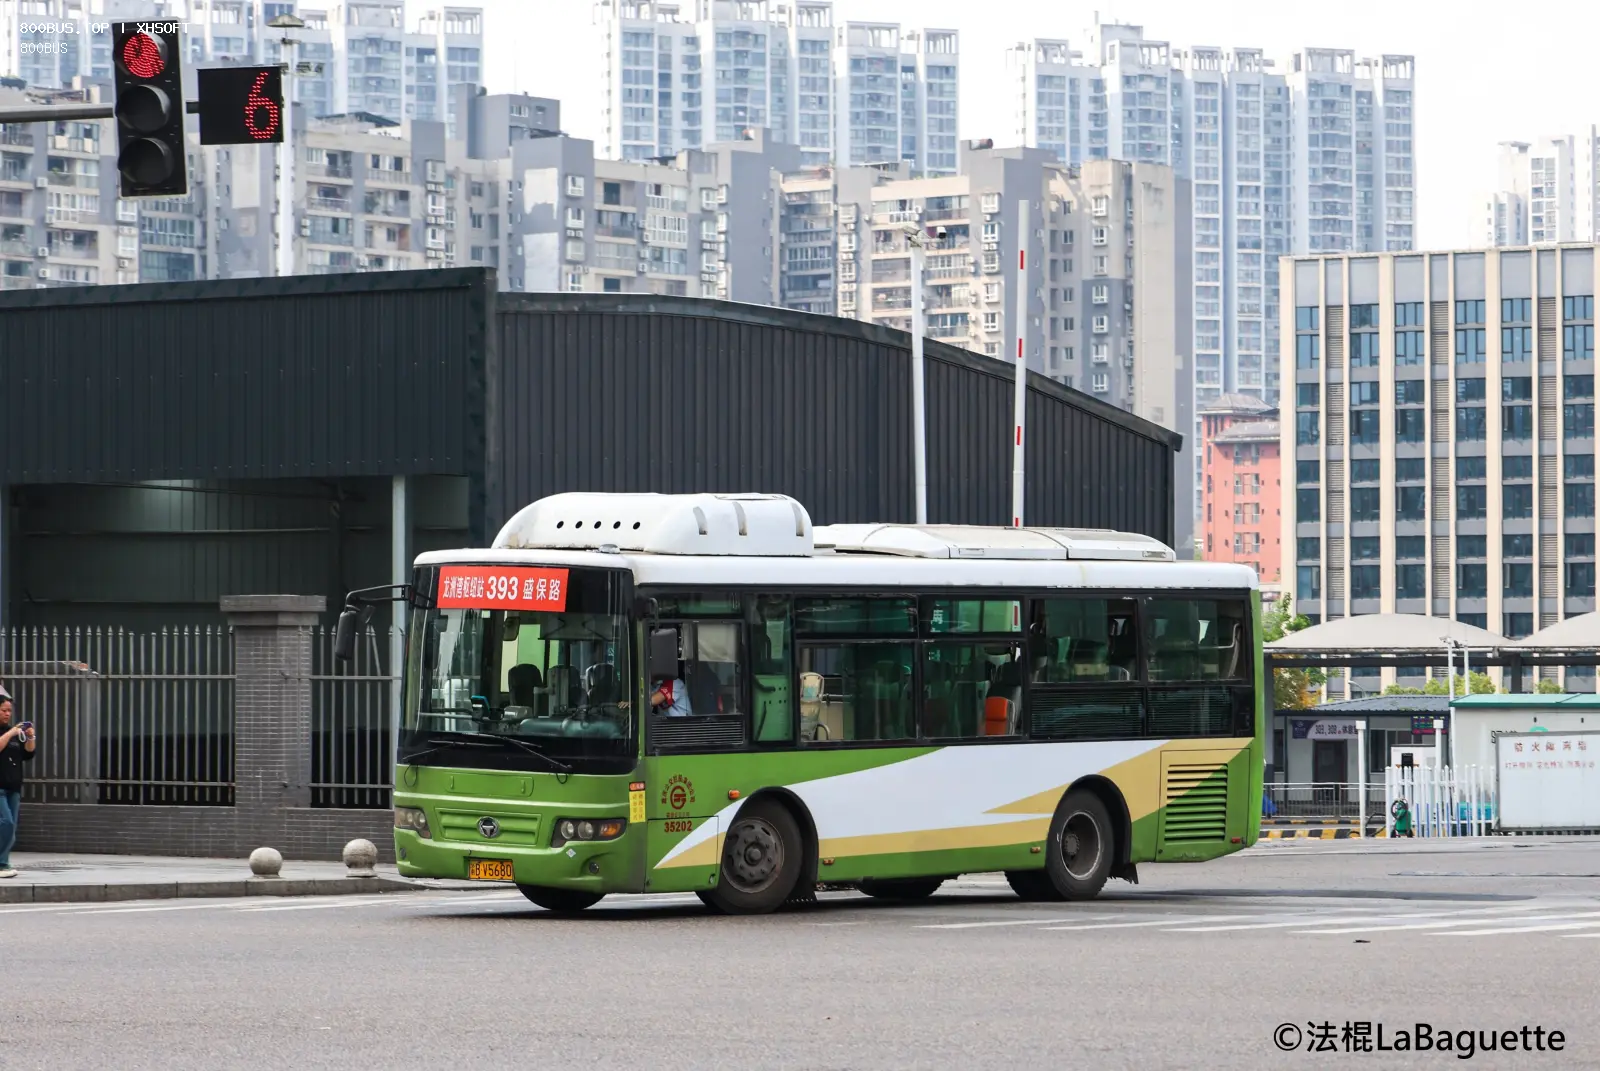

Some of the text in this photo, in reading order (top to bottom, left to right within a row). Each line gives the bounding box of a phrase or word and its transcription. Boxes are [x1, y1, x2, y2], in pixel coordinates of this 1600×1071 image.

[244, 71, 279, 139] 6
[442, 575, 561, 601] 龙洲湾枢纽站 393 盛保路
[664, 821, 693, 833] 35202
